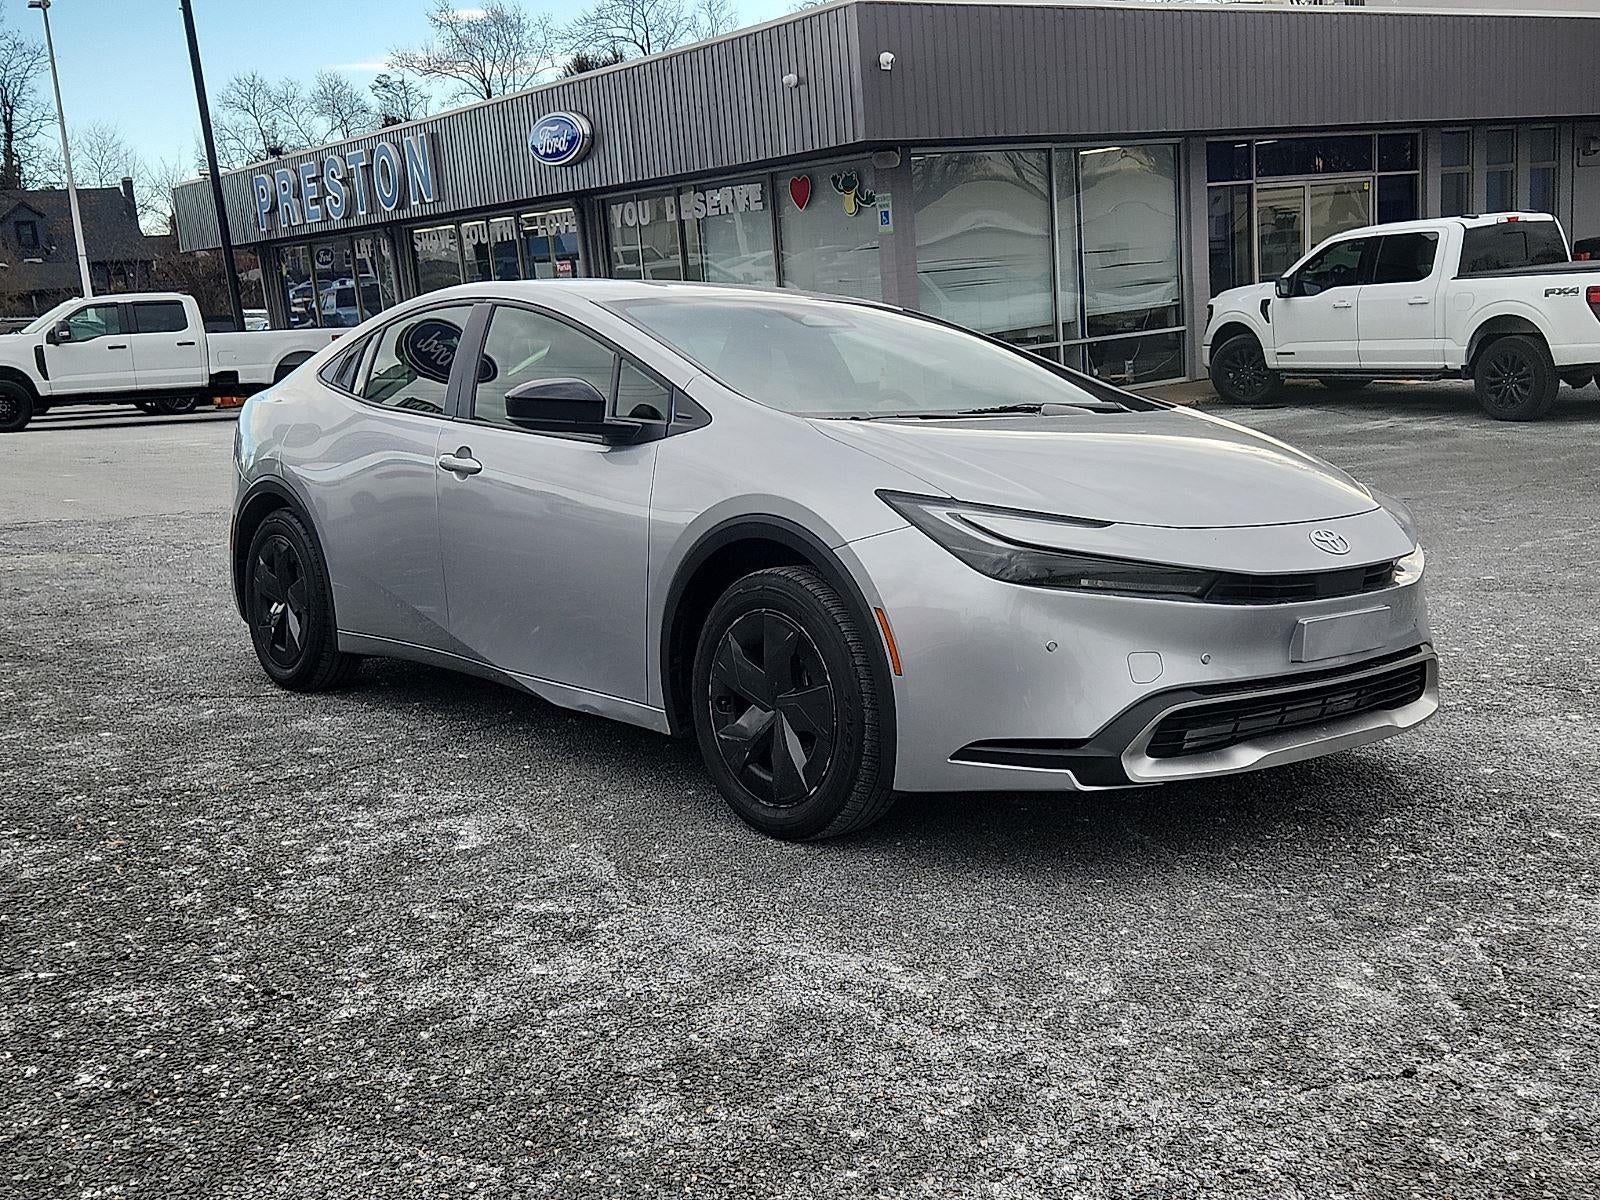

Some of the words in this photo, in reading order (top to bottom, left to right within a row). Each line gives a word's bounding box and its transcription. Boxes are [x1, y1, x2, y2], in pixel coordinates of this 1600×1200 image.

[537, 124, 569, 156] Ford
[253, 133, 436, 232] PRESTON
[537, 210, 577, 238] LOVE
[611, 200, 651, 228] YOU
[664, 183, 764, 223] DESERVE
[1544, 286, 1580, 298] FX4
